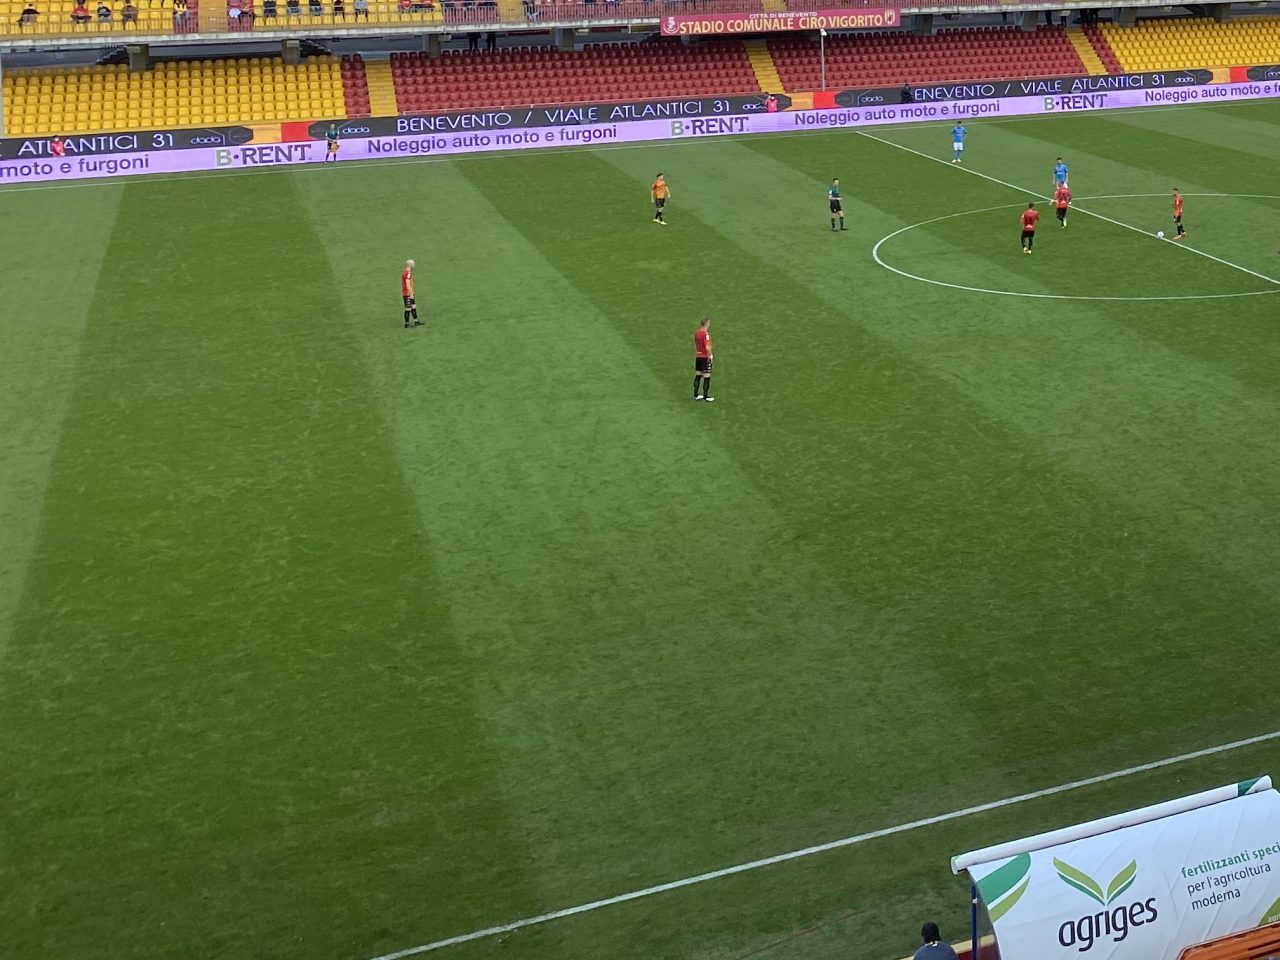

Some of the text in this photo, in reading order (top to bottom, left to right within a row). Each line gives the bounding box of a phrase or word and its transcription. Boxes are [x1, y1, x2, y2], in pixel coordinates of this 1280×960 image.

[679, 14, 883, 35] STADIO COMUNALE CIRO VIGORITO
[914, 84, 995, 101] ENEVENTO
[1021, 80, 1062, 94] VIALE
[1071, 75, 1143, 91] ATLANTICI
[1152, 74, 1166, 85] 31
[1145, 88, 1198, 105] Noleggio
[1202, 86, 1227, 99] auto
[1230, 84, 1261, 97] moto
[1264, 84, 1271, 93] e
[397, 112, 511, 132] BENEVENTO
[545, 107, 598, 123] VIALE
[610, 100, 702, 119] ATLANTICI
[713, 100, 731, 112] 31
[795, 100, 1000, 127] Noleggio auto moto e furgoni
[152, 133, 174, 148] 31
[367, 124, 617, 154] Noleggio auto moto e furgoni
[0, 154, 149, 178] moto e furgoni
[1181, 854, 1251, 879] fertilizzanti
[1187, 862, 1272, 896] per l'agricoltura
[1191, 887, 1242, 911] moderna
[1058, 896, 1158, 952] agriges
